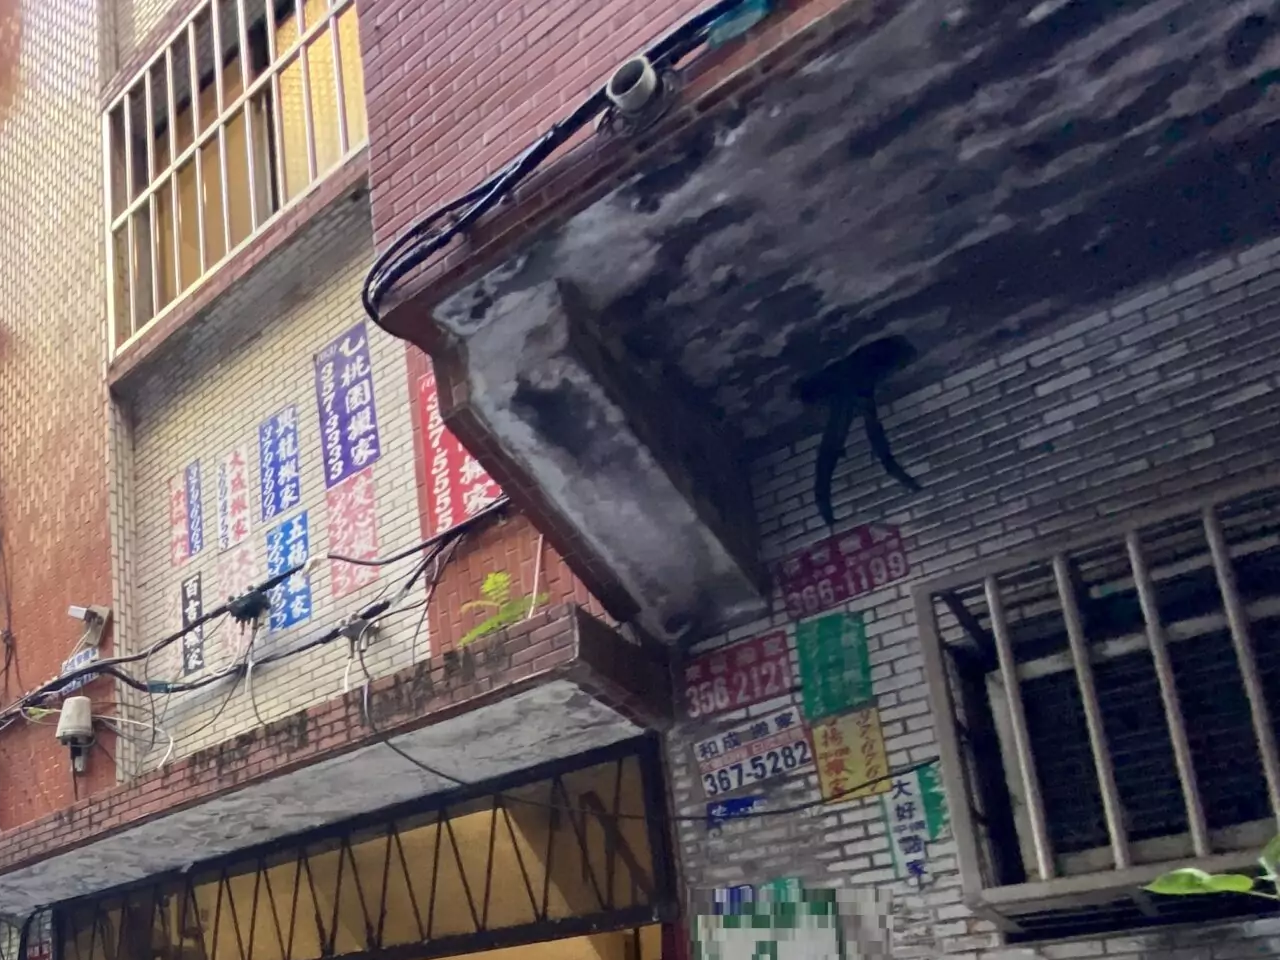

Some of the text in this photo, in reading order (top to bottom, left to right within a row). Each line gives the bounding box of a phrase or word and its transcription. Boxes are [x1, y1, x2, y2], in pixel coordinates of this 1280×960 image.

[276, 407, 300, 509] 興龍搬家
[787, 551, 908, 618] 366-1199
[704, 740, 812, 796] 367-5282
